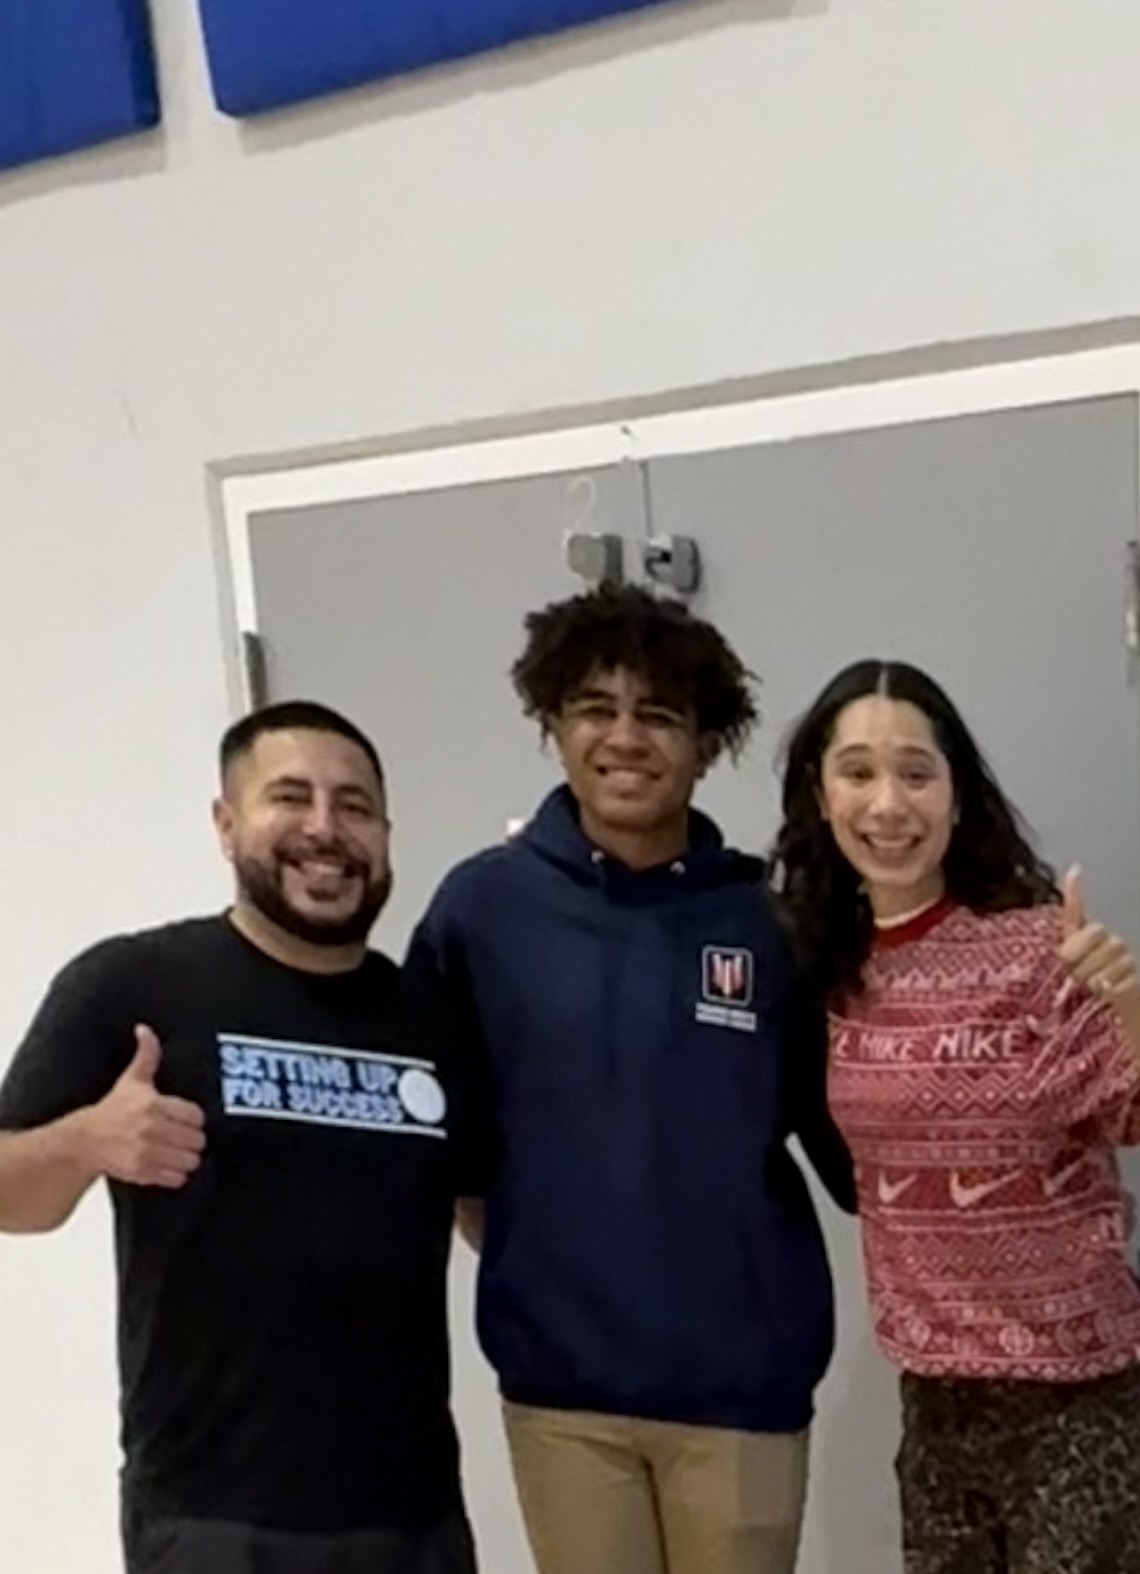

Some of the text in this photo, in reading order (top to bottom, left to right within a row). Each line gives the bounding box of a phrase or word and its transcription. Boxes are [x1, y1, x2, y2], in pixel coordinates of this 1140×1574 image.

[932, 1026, 1025, 1059] NIKE
[220, 1045, 398, 1094] SETTING UP
[223, 1078, 404, 1123] FOR SUCCESS
